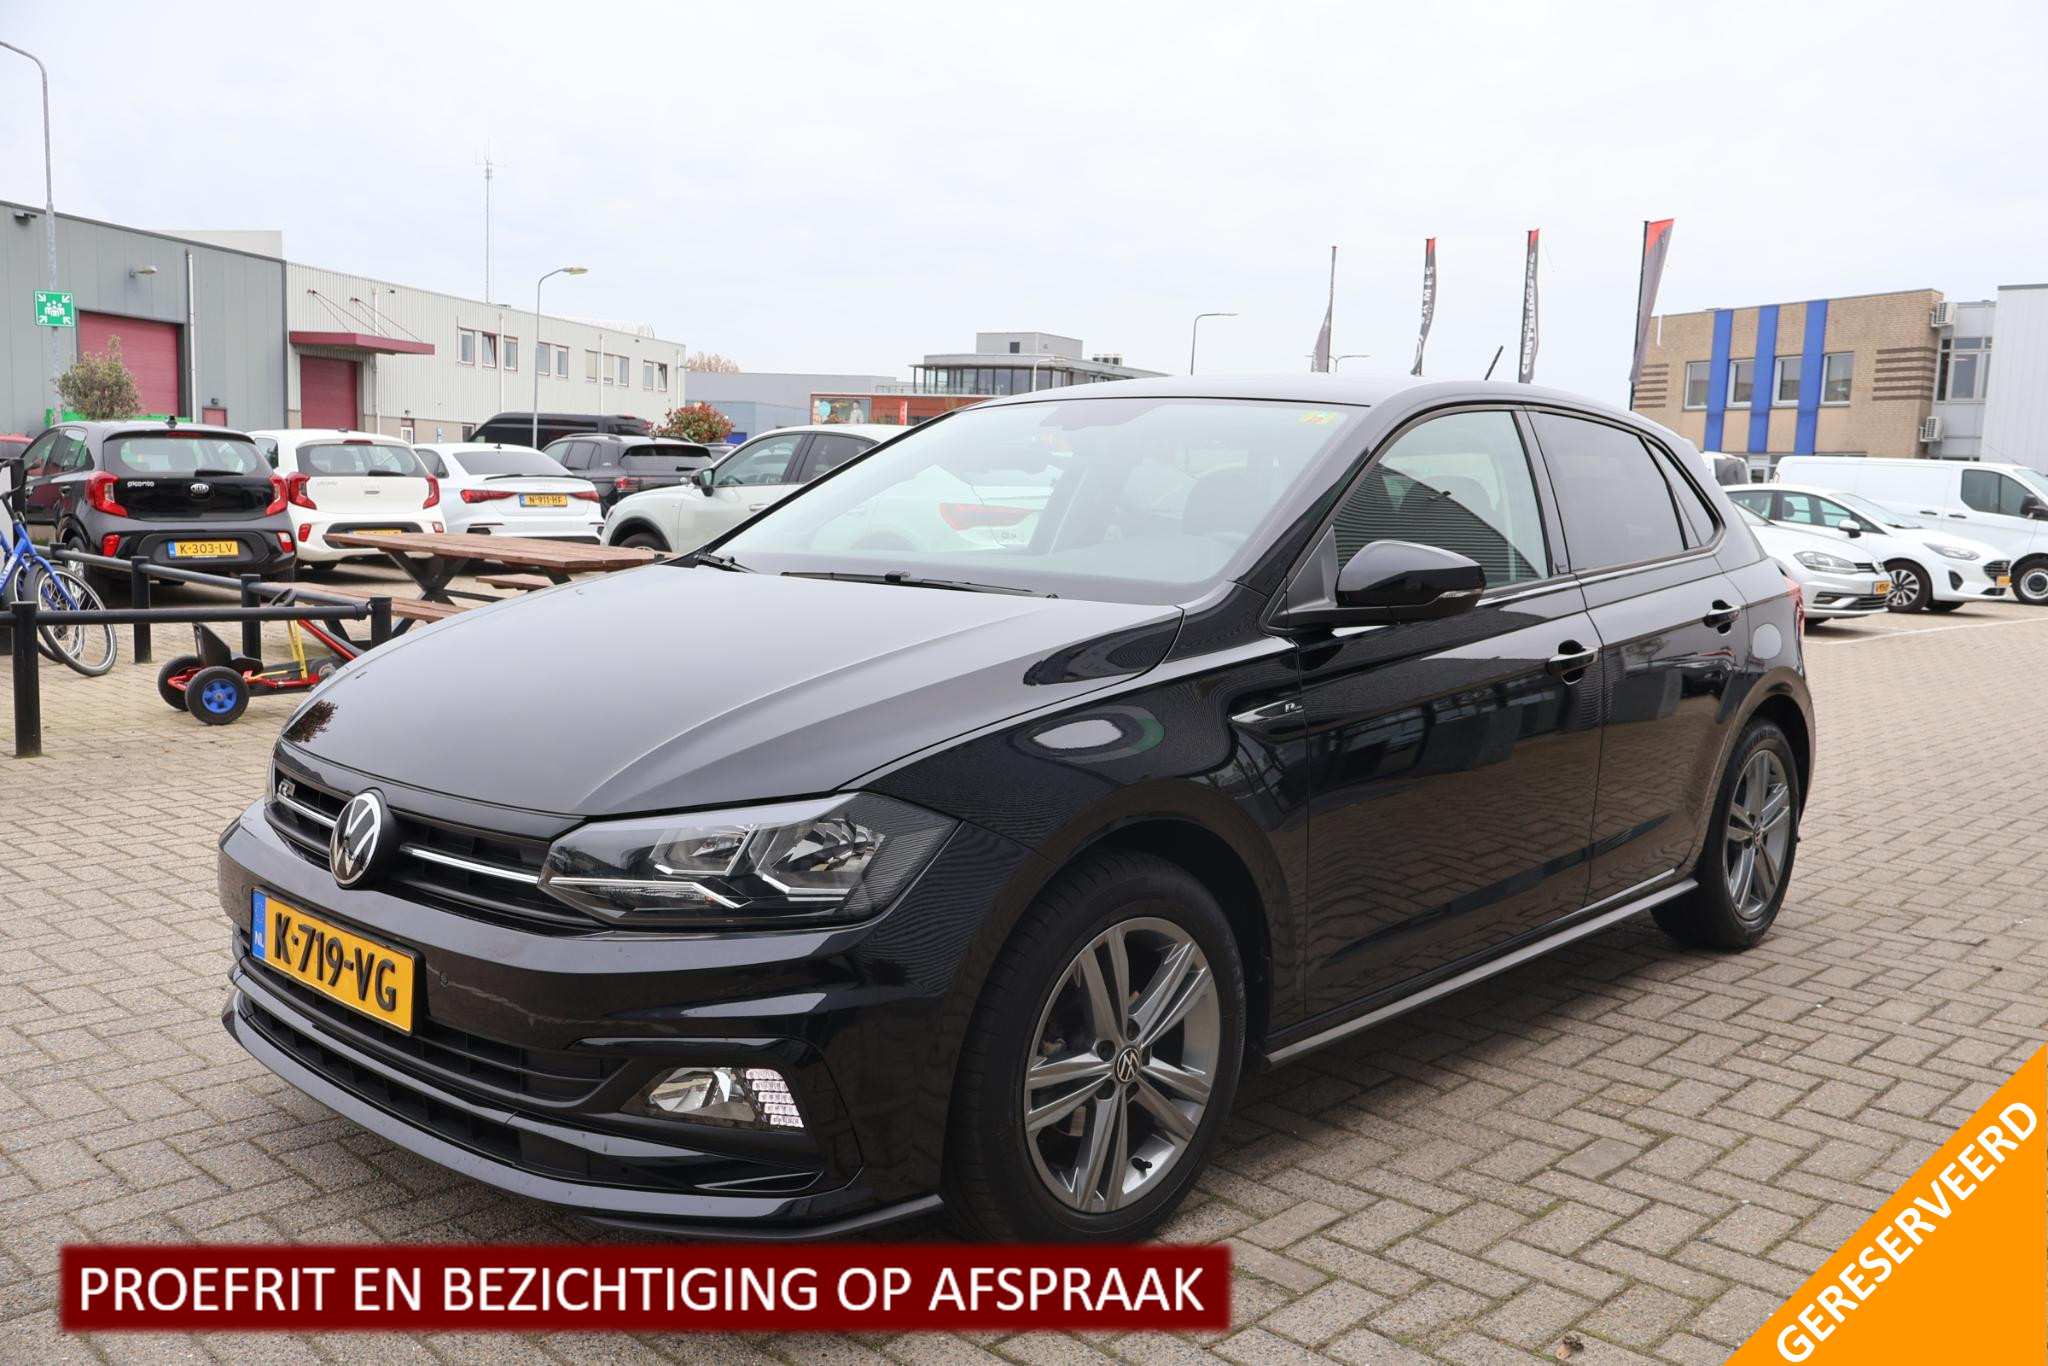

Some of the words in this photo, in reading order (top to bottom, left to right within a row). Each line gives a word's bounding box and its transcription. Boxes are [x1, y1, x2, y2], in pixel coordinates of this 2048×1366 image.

[180, 543, 233, 554] K-303-LV
[254, 930, 265, 948] NL
[274, 912, 397, 1012] K-719-VG
